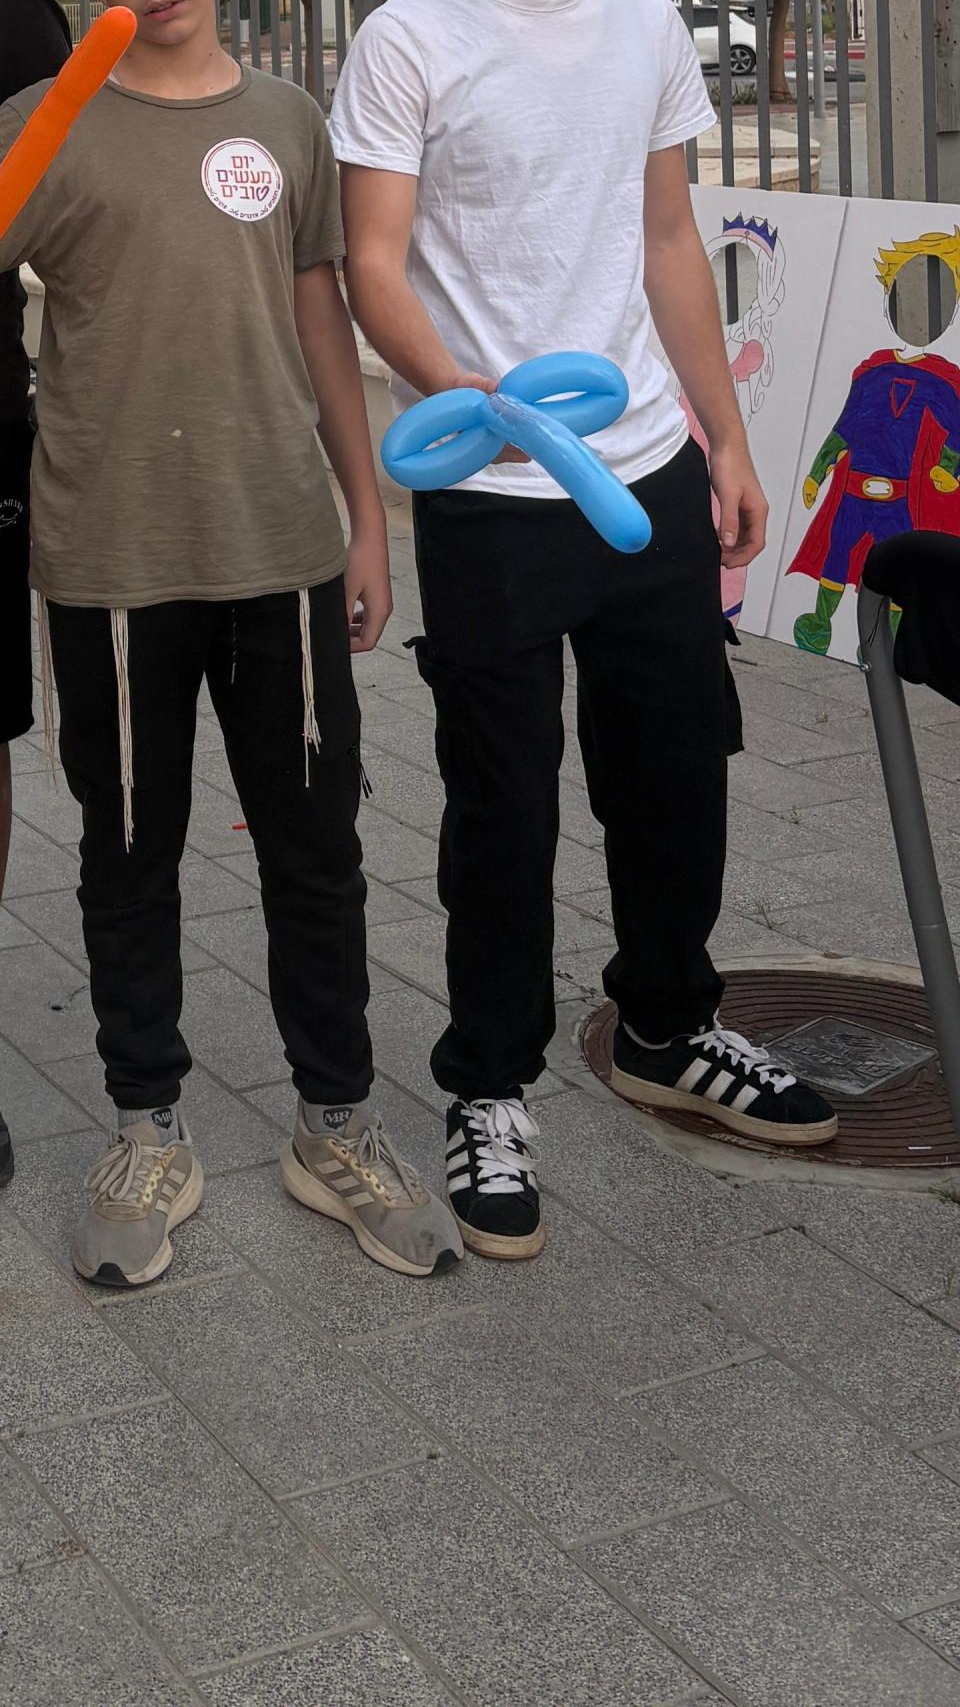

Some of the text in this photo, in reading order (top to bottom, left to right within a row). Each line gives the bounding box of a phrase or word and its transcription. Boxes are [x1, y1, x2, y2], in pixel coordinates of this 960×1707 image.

[231, 155, 255, 169] יום
[215, 169, 272, 185] מעשים
[220, 184, 270, 202] טובים
